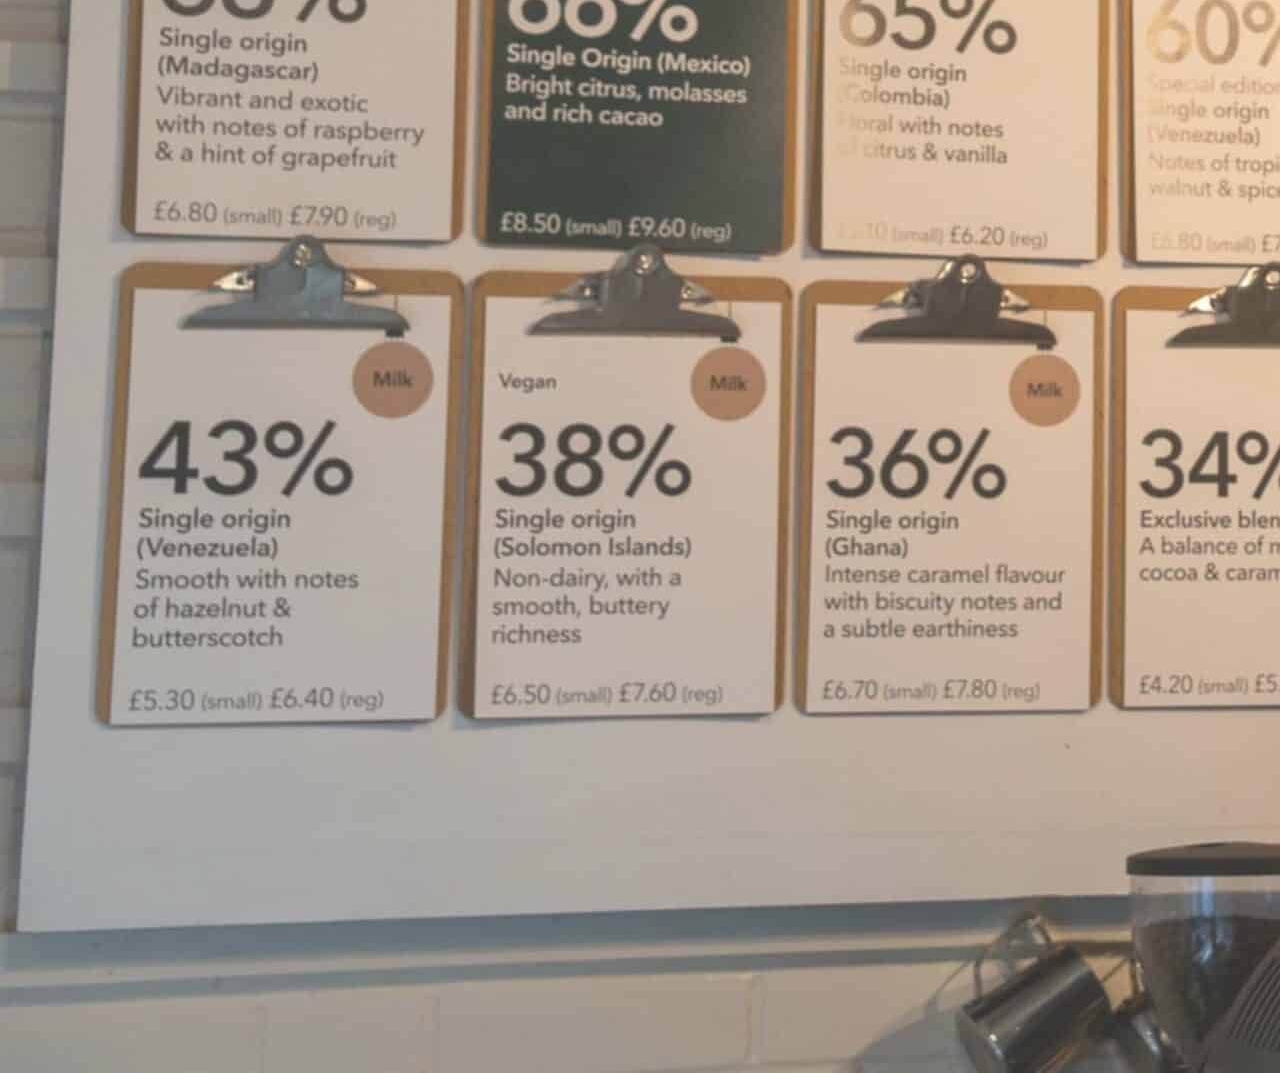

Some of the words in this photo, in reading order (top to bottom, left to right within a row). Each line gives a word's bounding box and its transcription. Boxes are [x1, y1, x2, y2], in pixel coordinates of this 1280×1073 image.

[158, 54, 318, 84] (Madagascar)
[507, 45, 576, 69] Single
[582, 49, 651, 73] Origin
[657, 53, 751, 77] (Mexico)
[157, 85, 242, 108] Vibrant
[249, 90, 293, 111] and
[301, 94, 368, 113] exotic
[506, 73, 571, 104] Bright
[578, 77, 641, 105] citrus,
[649, 81, 747, 104] molasses
[154, 199, 217, 223] £6.80
[224, 207, 282, 231] (small)
[288, 205, 348, 227] £7.90
[354, 207, 396, 232] (reg)
[374, 371, 412, 388] Milk
[139, 419, 353, 497] 43%
[496, 423, 691, 498] 38%
[827, 426, 1006, 500] 36%
[494, 536, 601, 560] (Solomon
[609, 536, 691, 559] Islands)
[826, 536, 908, 560] (Ghana)
[494, 567, 608, 593] Non-dairy,
[616, 567, 662, 587] with
[669, 573, 681, 587] a
[825, 564, 901, 583] Intense
[908, 563, 989, 583] caramel
[996, 563, 1065, 583] flavour
[1139, 567, 1198, 582] cocoa
[1204, 562, 1219, 581] &
[134, 597, 160, 619] of
[166, 597, 266, 619] hazelnut
[273, 597, 290, 618] &
[132, 625, 283, 648] butterscotch
